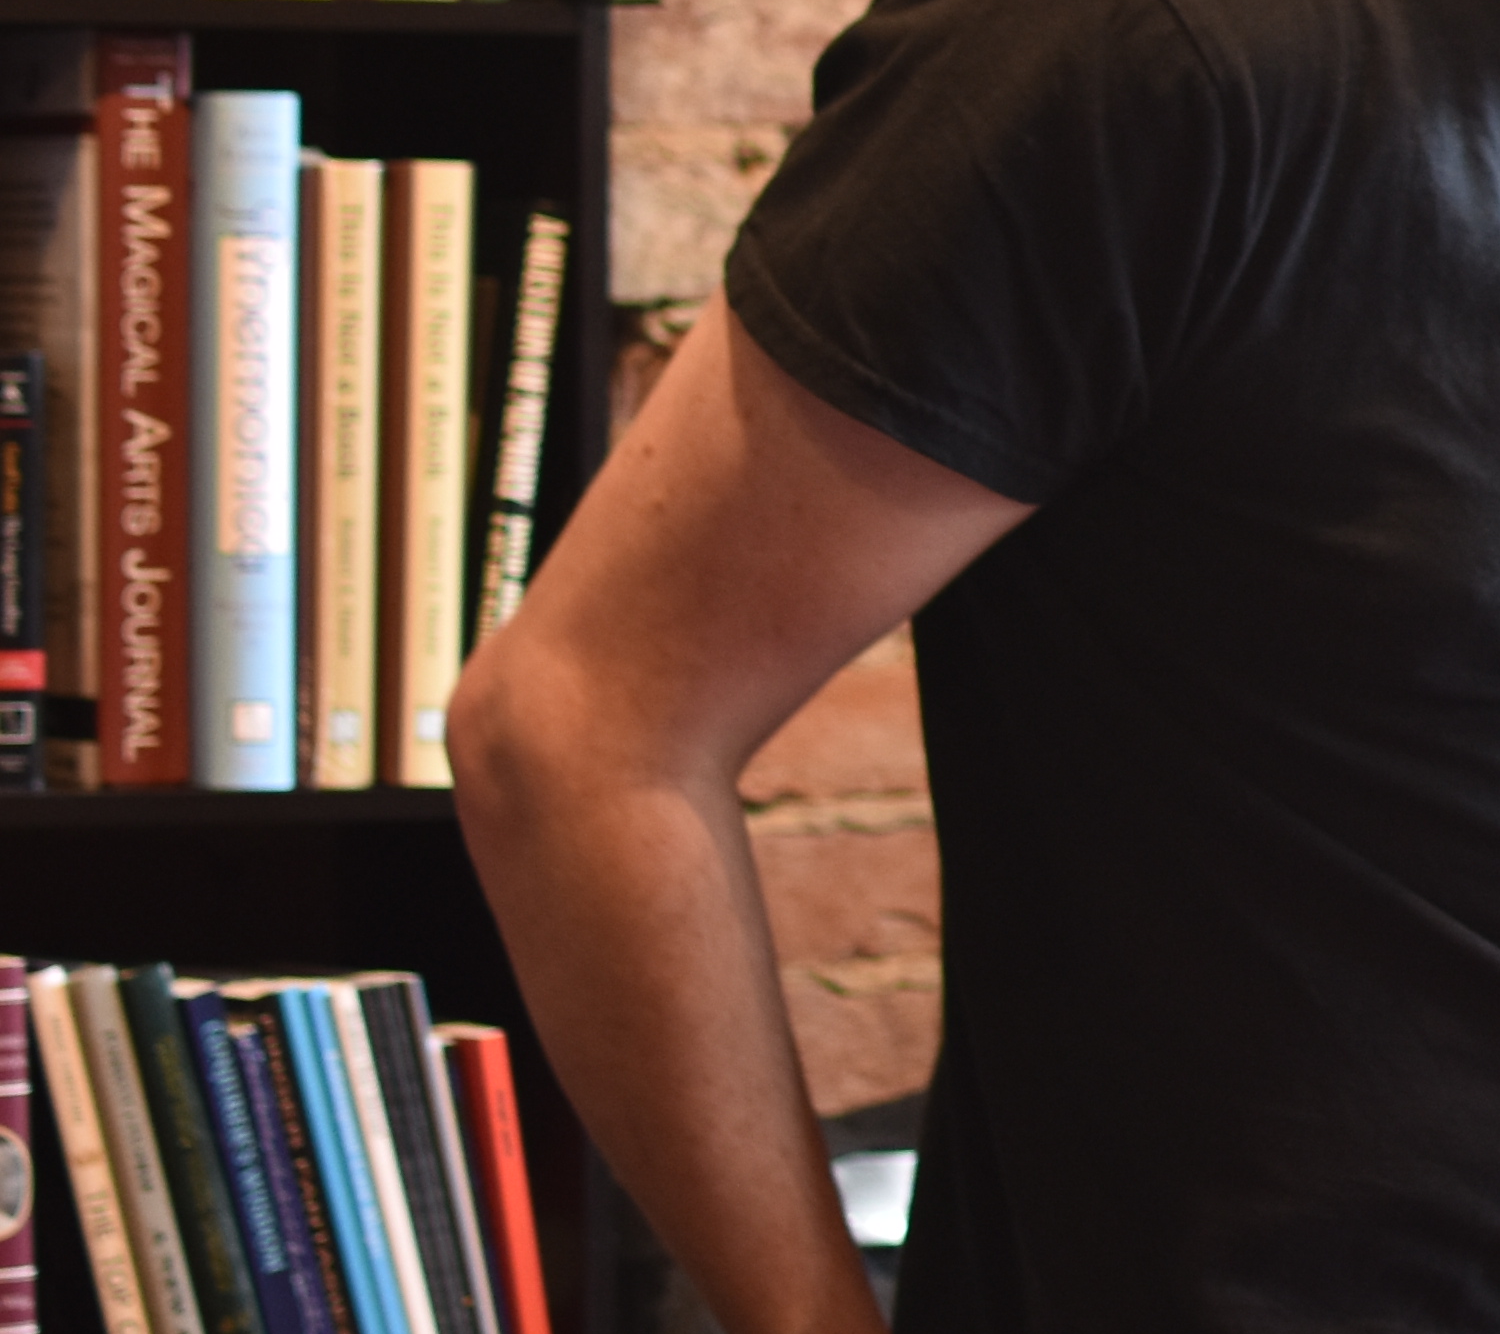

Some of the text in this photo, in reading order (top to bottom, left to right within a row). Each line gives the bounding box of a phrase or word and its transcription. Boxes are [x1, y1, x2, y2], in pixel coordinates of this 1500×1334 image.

[121, 72, 173, 764] THE MAGICAL ARTS JOURNAL
[83, 1189, 117, 1241] THE
[99, 1254, 134, 1310] TOP
